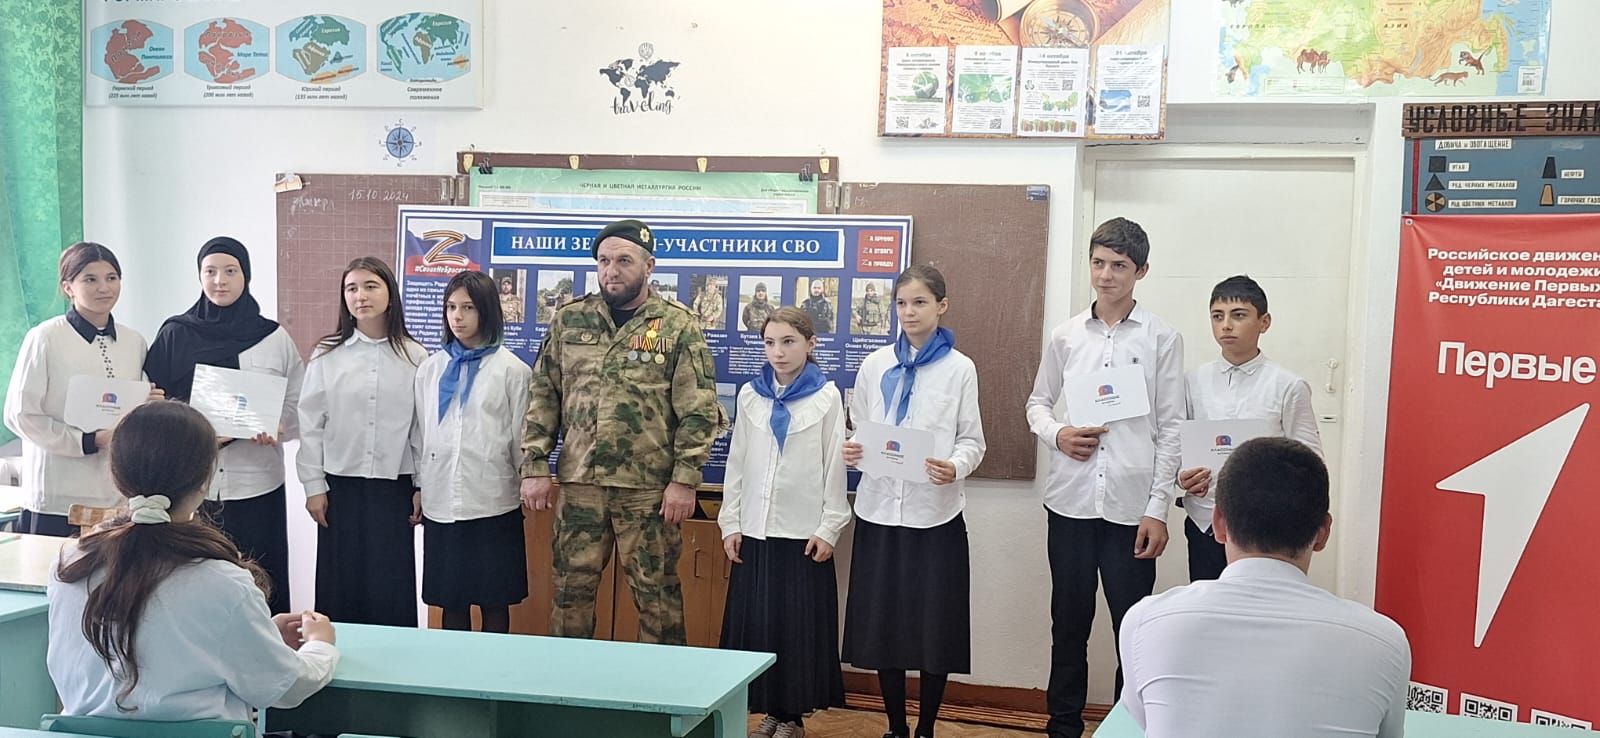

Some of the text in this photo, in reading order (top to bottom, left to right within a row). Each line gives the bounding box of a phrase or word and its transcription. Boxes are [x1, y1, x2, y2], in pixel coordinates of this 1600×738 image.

[610, 91, 674, 115] traveling
[511, 236, 566, 250] НАШИ
[782, 239, 820, 254] СВО
[1428, 248, 1530, 261] Российское
[1442, 263, 1494, 276] детей
[1496, 266, 1508, 275] и
[1435, 277, 1531, 291] «Движение
[1428, 291, 1530, 307] Республики
[1437, 341, 1597, 389] Первые
